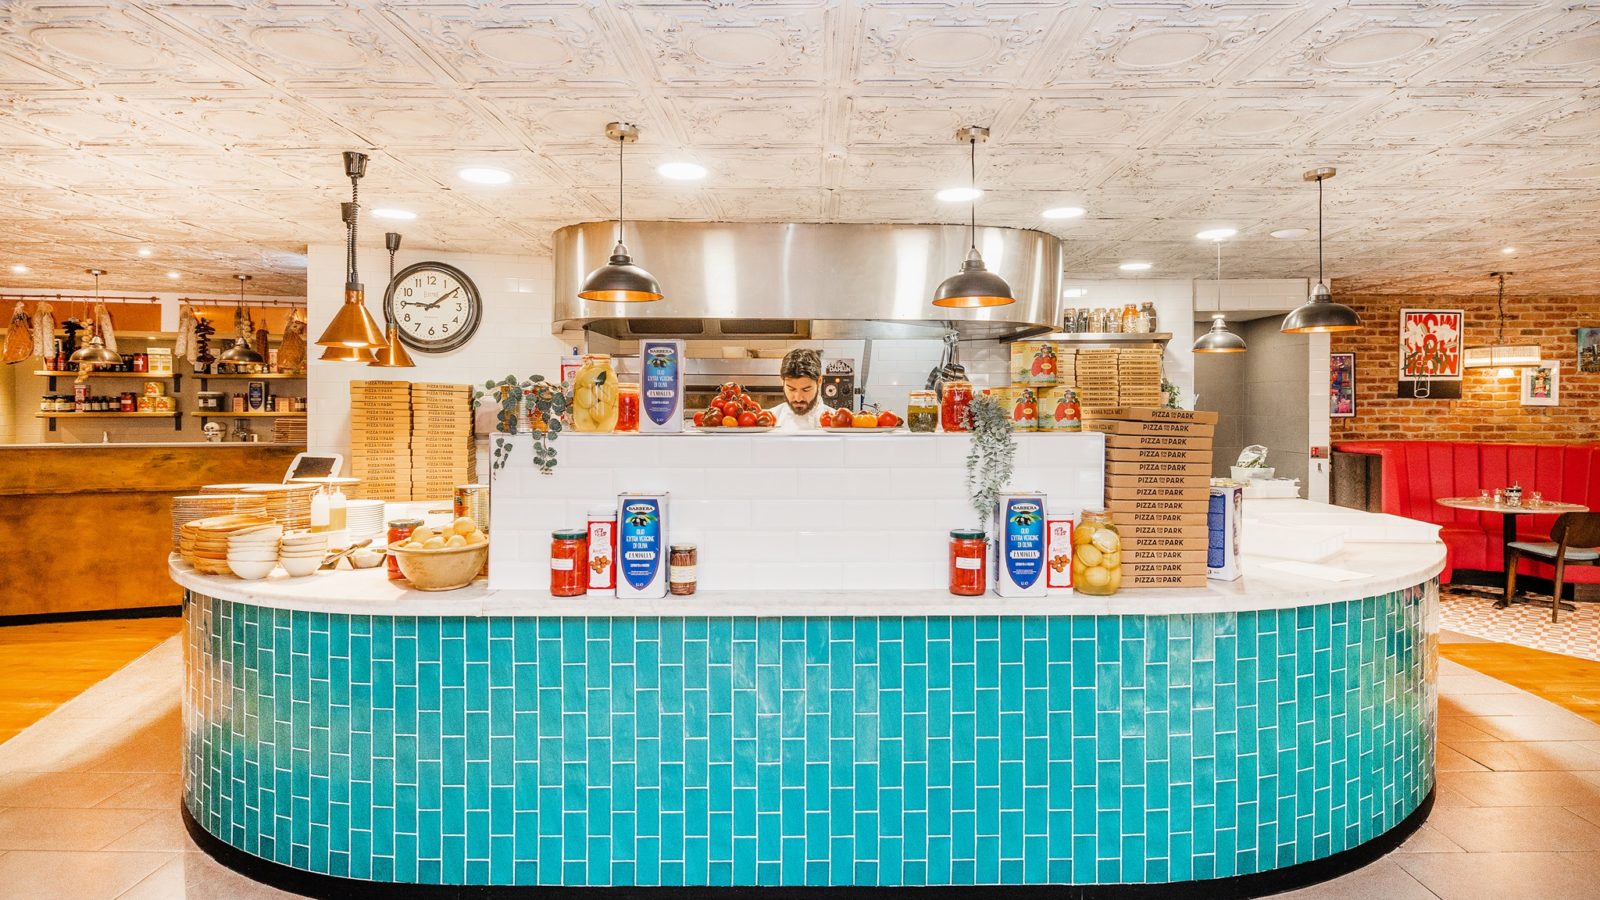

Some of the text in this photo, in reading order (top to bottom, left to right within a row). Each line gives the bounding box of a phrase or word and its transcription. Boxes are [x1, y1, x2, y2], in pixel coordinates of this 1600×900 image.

[415, 279, 422, 288] 11
[427, 276, 437, 285] 12
[444, 280, 447, 289] 1
[404, 288, 413, 297] 10
[452, 288, 459, 299] 2
[400, 300, 406, 309] 9
[456, 303, 462, 312] 3
[404, 313, 411, 322] 8
[414, 322, 421, 332] 7
[428, 326, 435, 336] 6
[442, 324, 449, 333] 5
